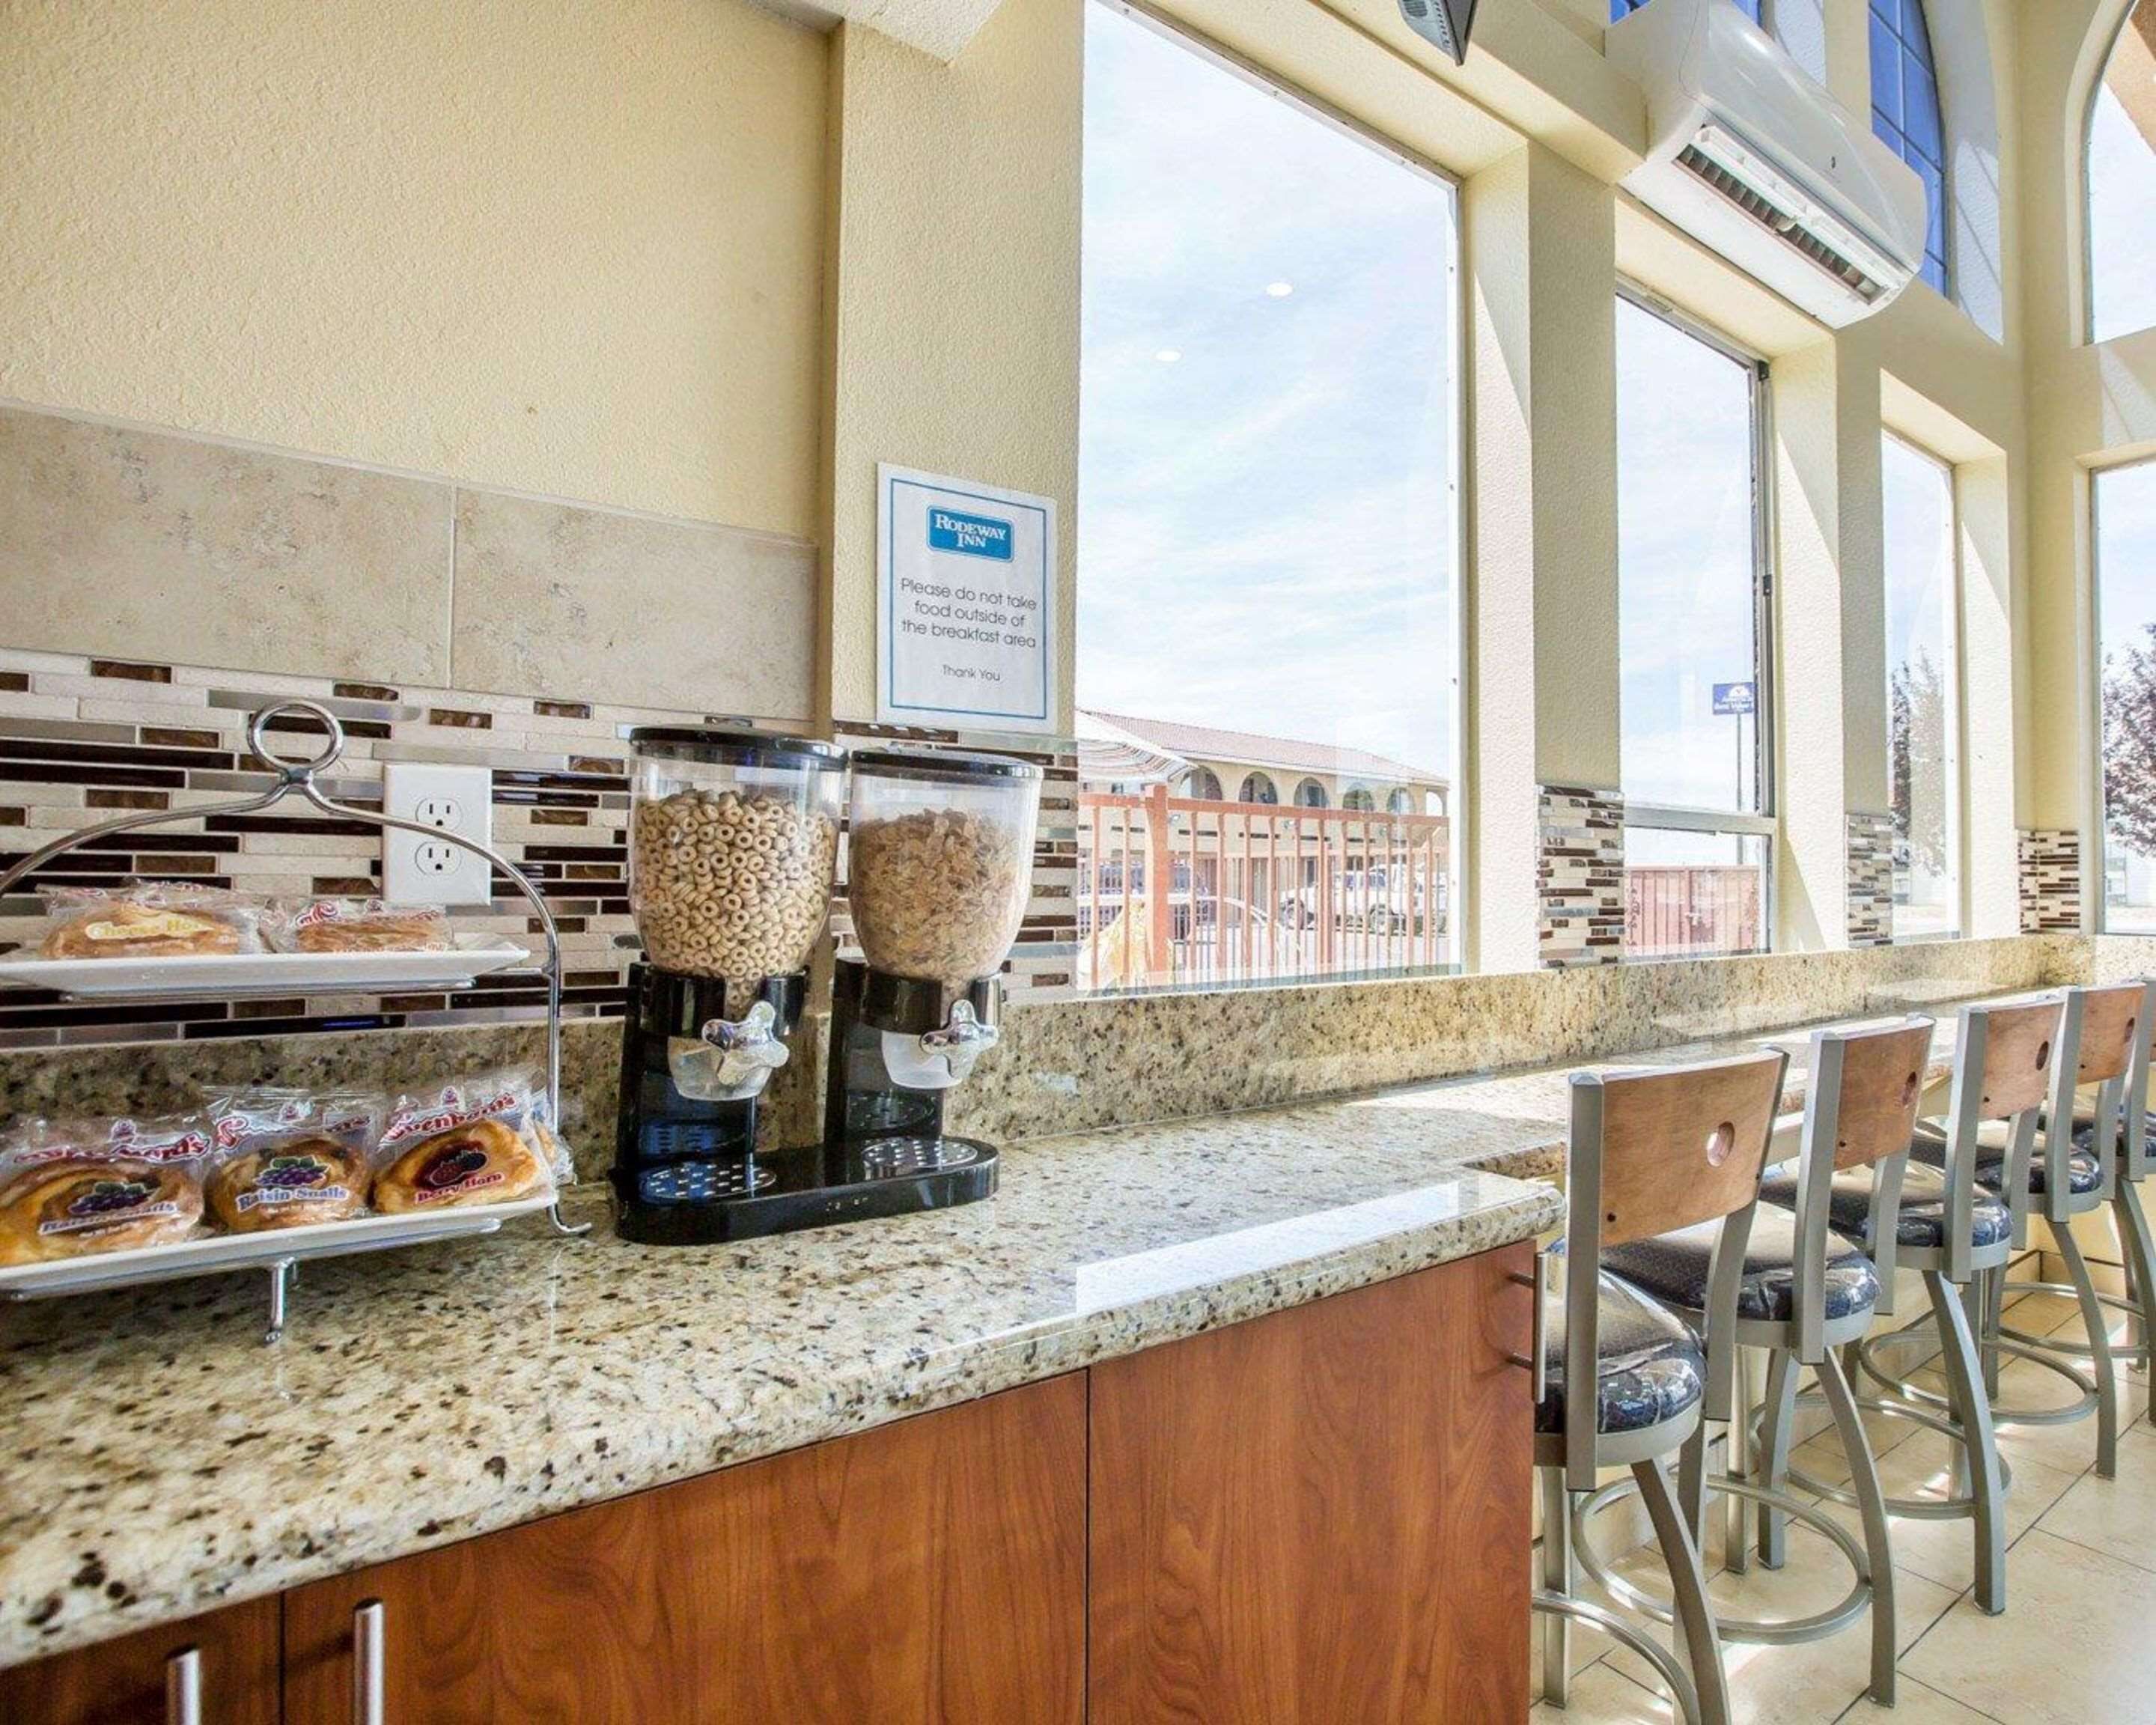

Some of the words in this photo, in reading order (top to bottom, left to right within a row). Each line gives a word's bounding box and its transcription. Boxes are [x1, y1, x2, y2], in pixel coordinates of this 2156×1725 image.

[934, 514, 1006, 540] RODEWAY
[957, 533, 987, 547] INN
[901, 577, 951, 597] Please
[954, 587, 976, 601] do
[980, 591, 1003, 605] not
[1007, 594, 1037, 610] take
[914, 600, 951, 618] food
[954, 607, 1007, 624] outside
[1011, 615, 1026, 627] of
[902, 619, 928, 635] the
[932, 622, 1000, 642] breakfast
[1003, 634, 1035, 648] area
[943, 664, 976, 679] Thank
[978, 669, 1001, 681] You
[237, 1187, 292, 1211] Raisin
[295, 1186, 347, 1199] Snails
